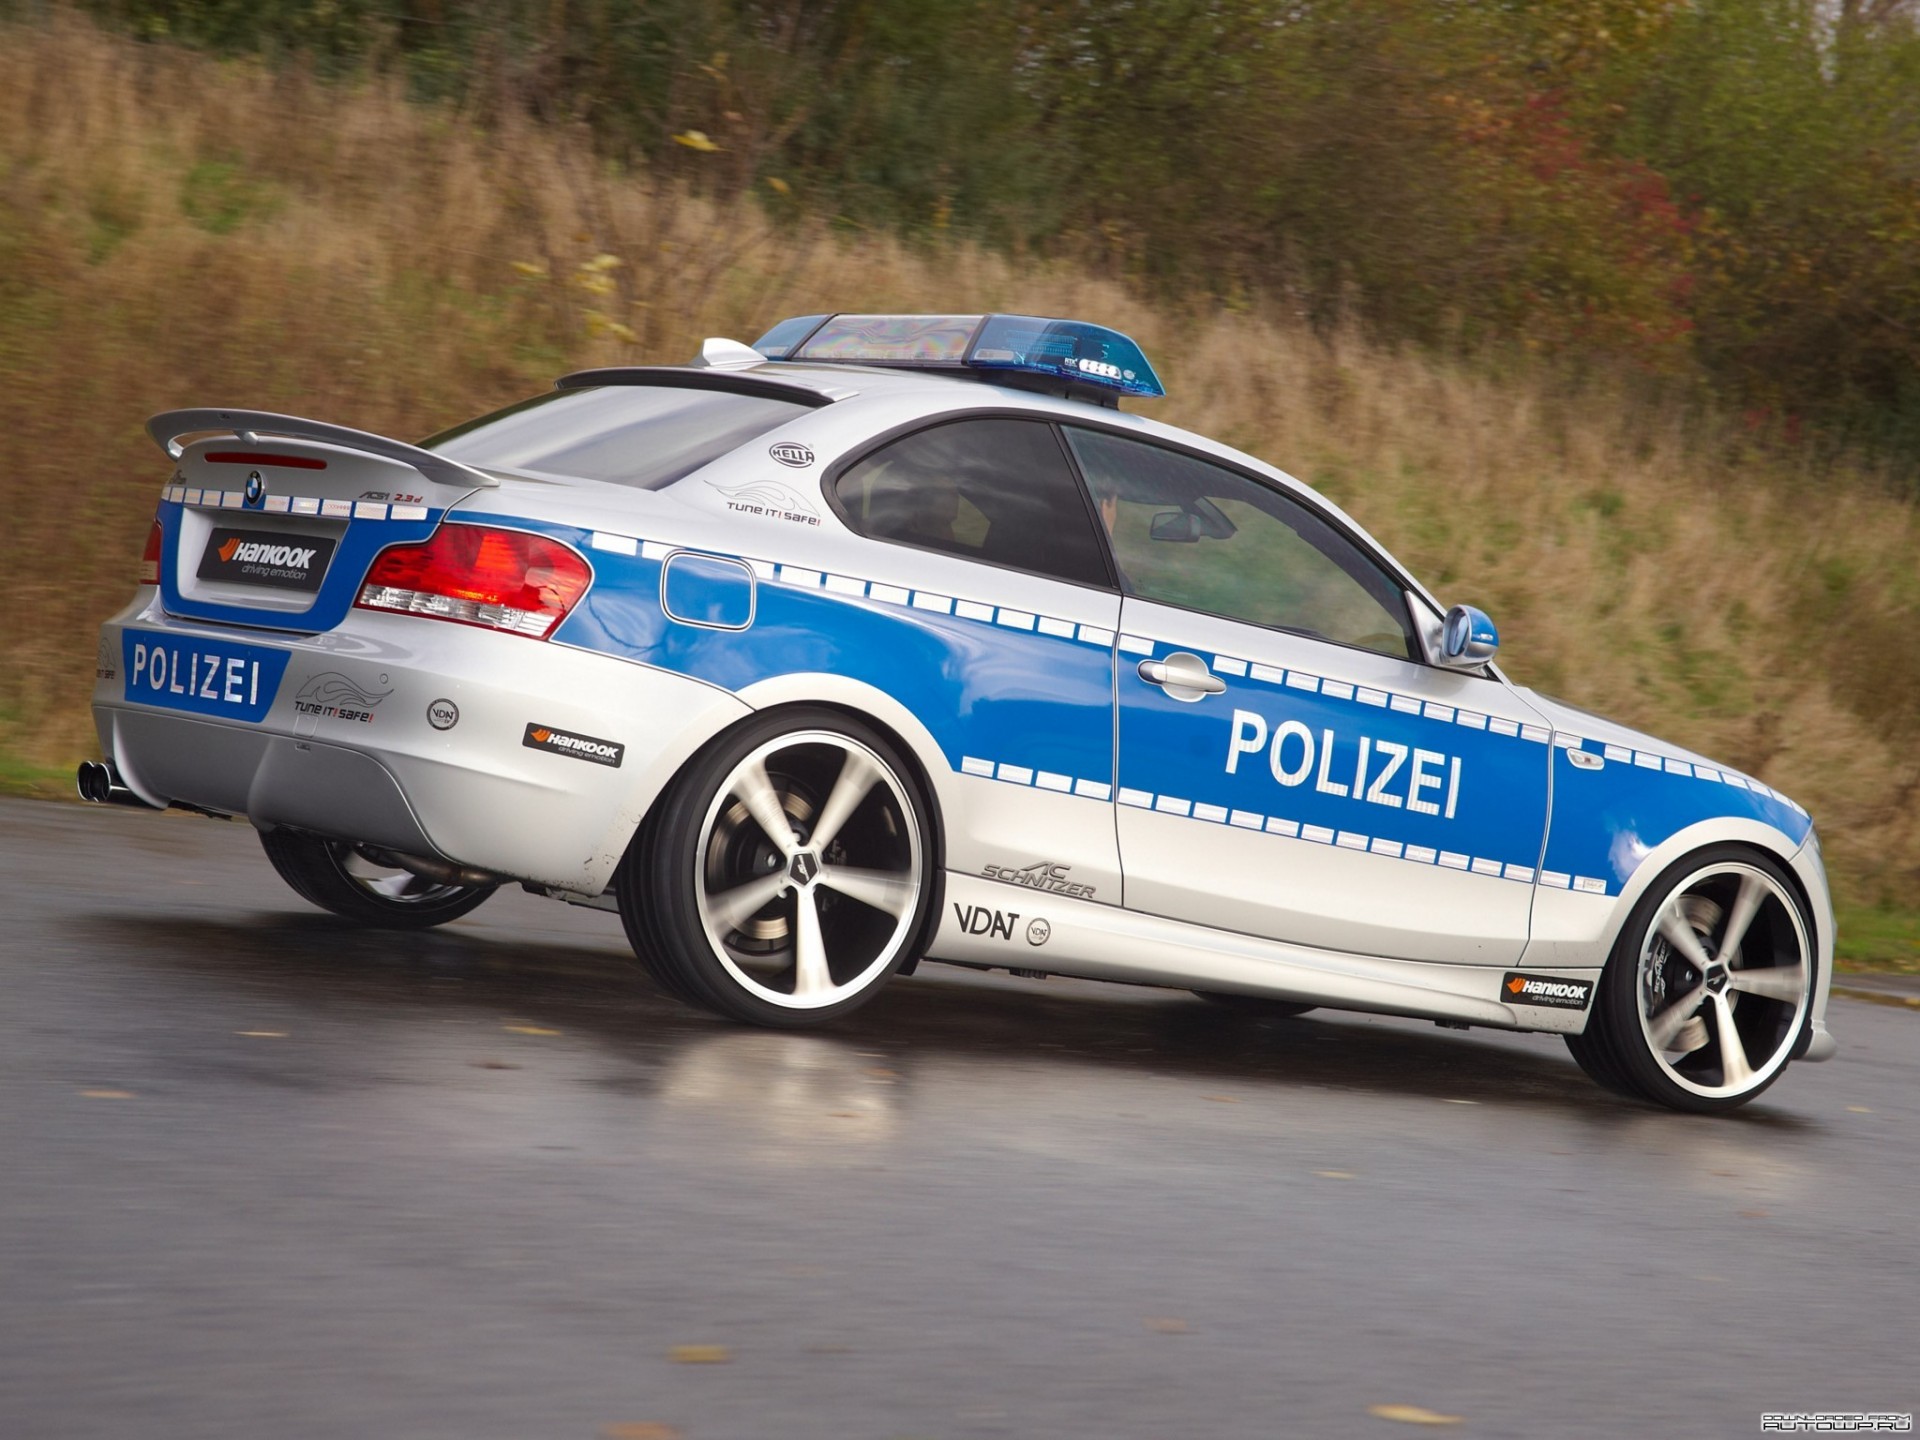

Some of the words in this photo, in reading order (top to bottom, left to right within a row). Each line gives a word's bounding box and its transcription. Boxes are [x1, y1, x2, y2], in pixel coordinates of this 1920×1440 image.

[773, 449, 815, 463] HELLA
[241, 564, 270, 577] driving
[270, 568, 307, 580] emotion
[133, 644, 259, 705] POLIZEI
[1225, 708, 1462, 819] POLIZEI
[981, 864, 1096, 899] SCHNITZER
[1022, 860, 1072, 880] AC
